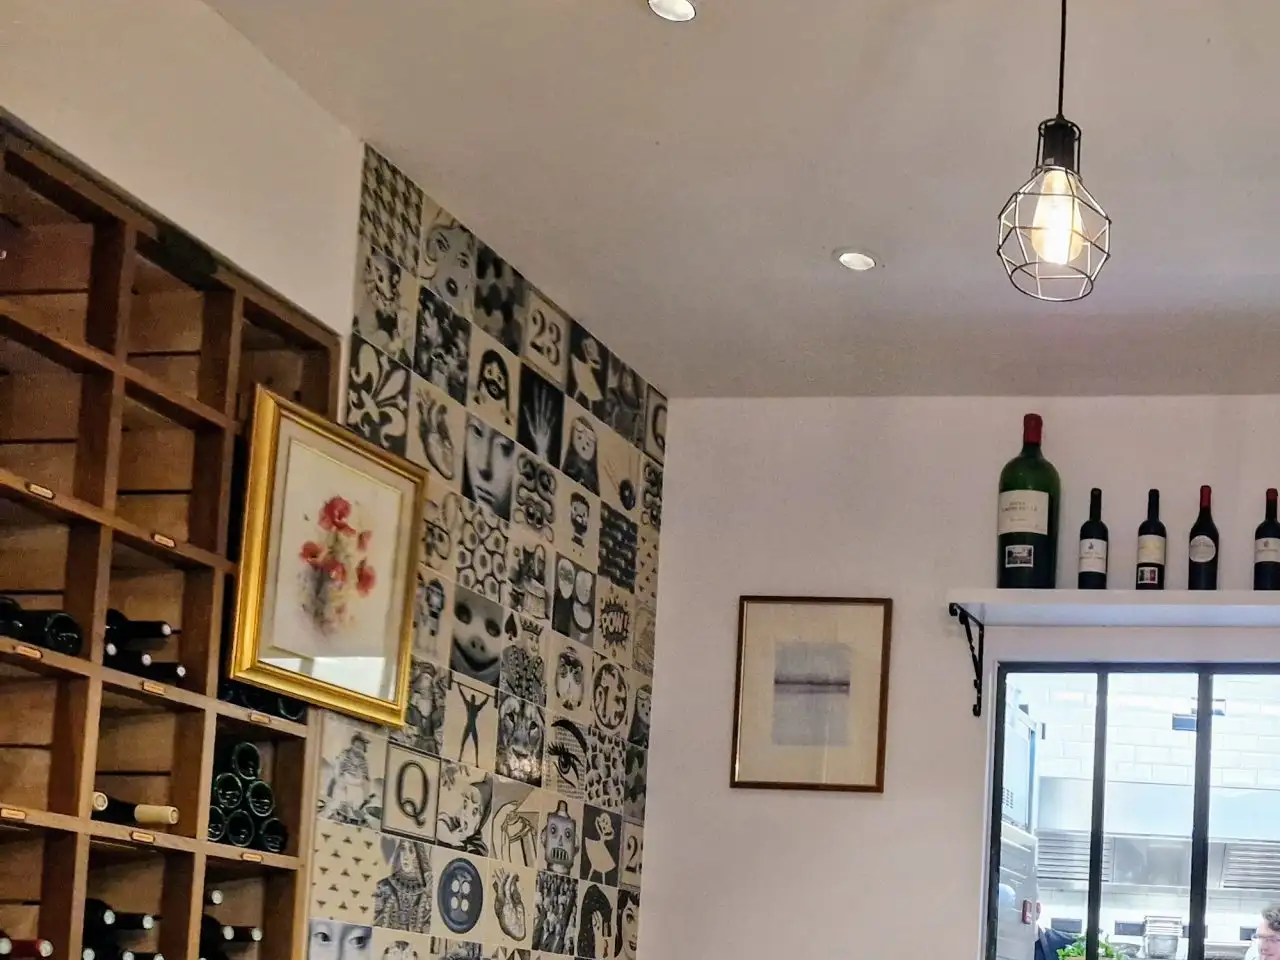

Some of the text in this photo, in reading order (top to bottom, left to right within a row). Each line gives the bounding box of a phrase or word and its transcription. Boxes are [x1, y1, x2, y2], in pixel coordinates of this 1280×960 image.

[530, 309, 562, 367] 23
[601, 611, 629, 637] POW!
[396, 759, 430, 828] Q
